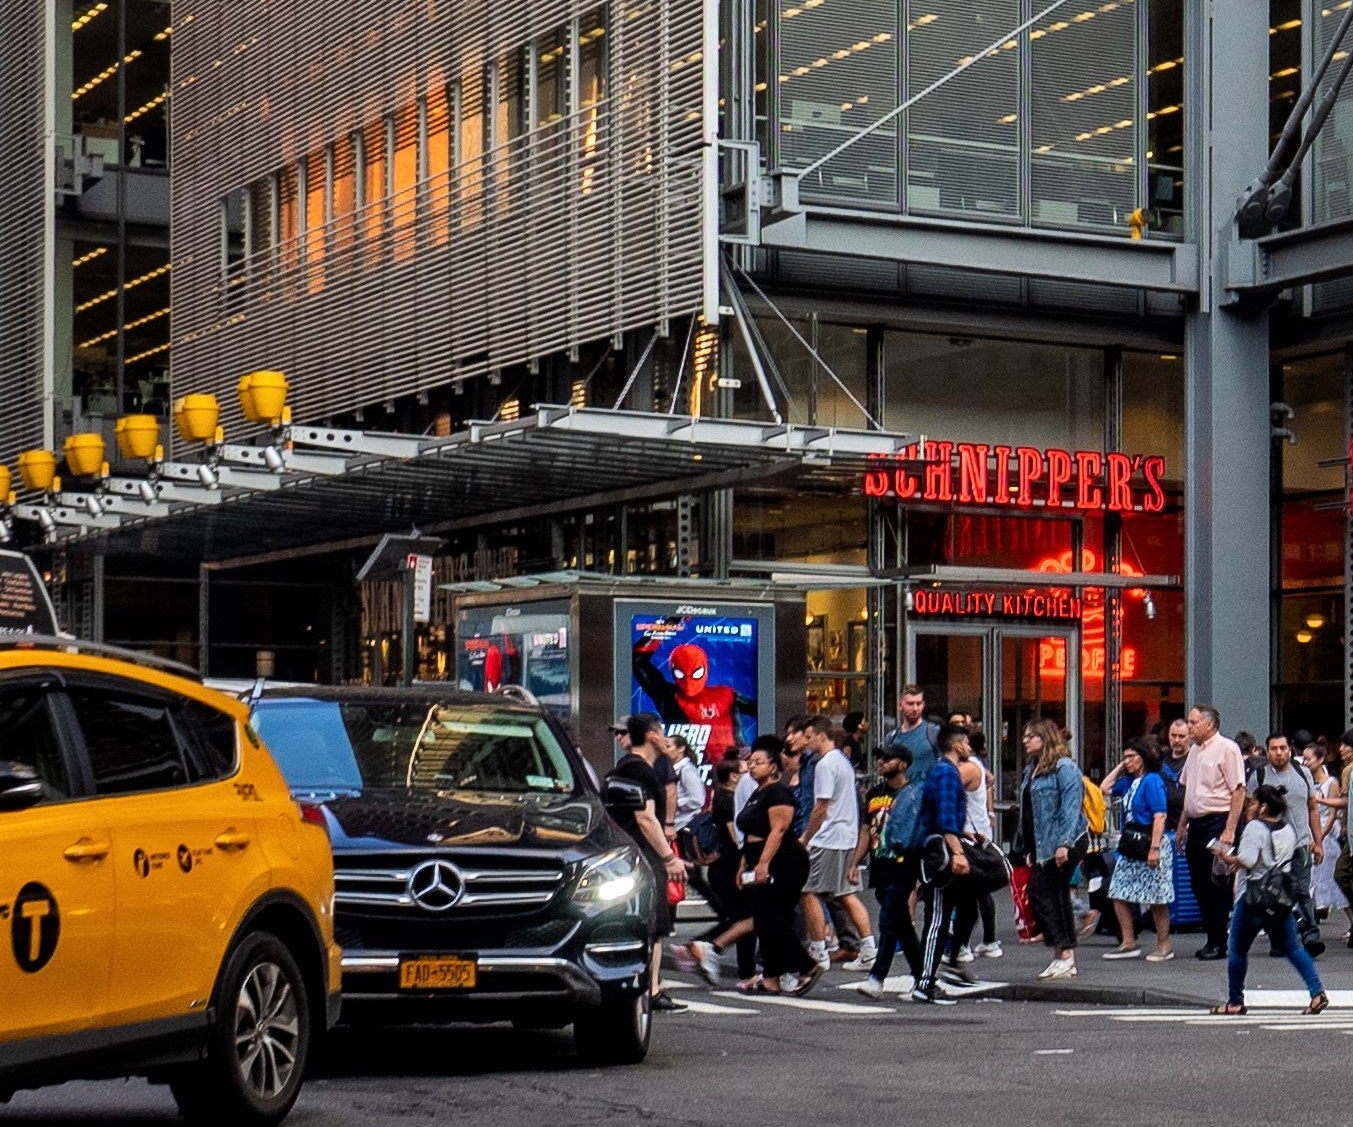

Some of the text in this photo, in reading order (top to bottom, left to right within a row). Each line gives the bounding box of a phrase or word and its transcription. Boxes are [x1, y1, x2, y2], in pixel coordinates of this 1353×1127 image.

[864, 441, 1167, 512] SCHNIPPER'S
[914, 590, 1081, 619] QUALITY KITCHEN
